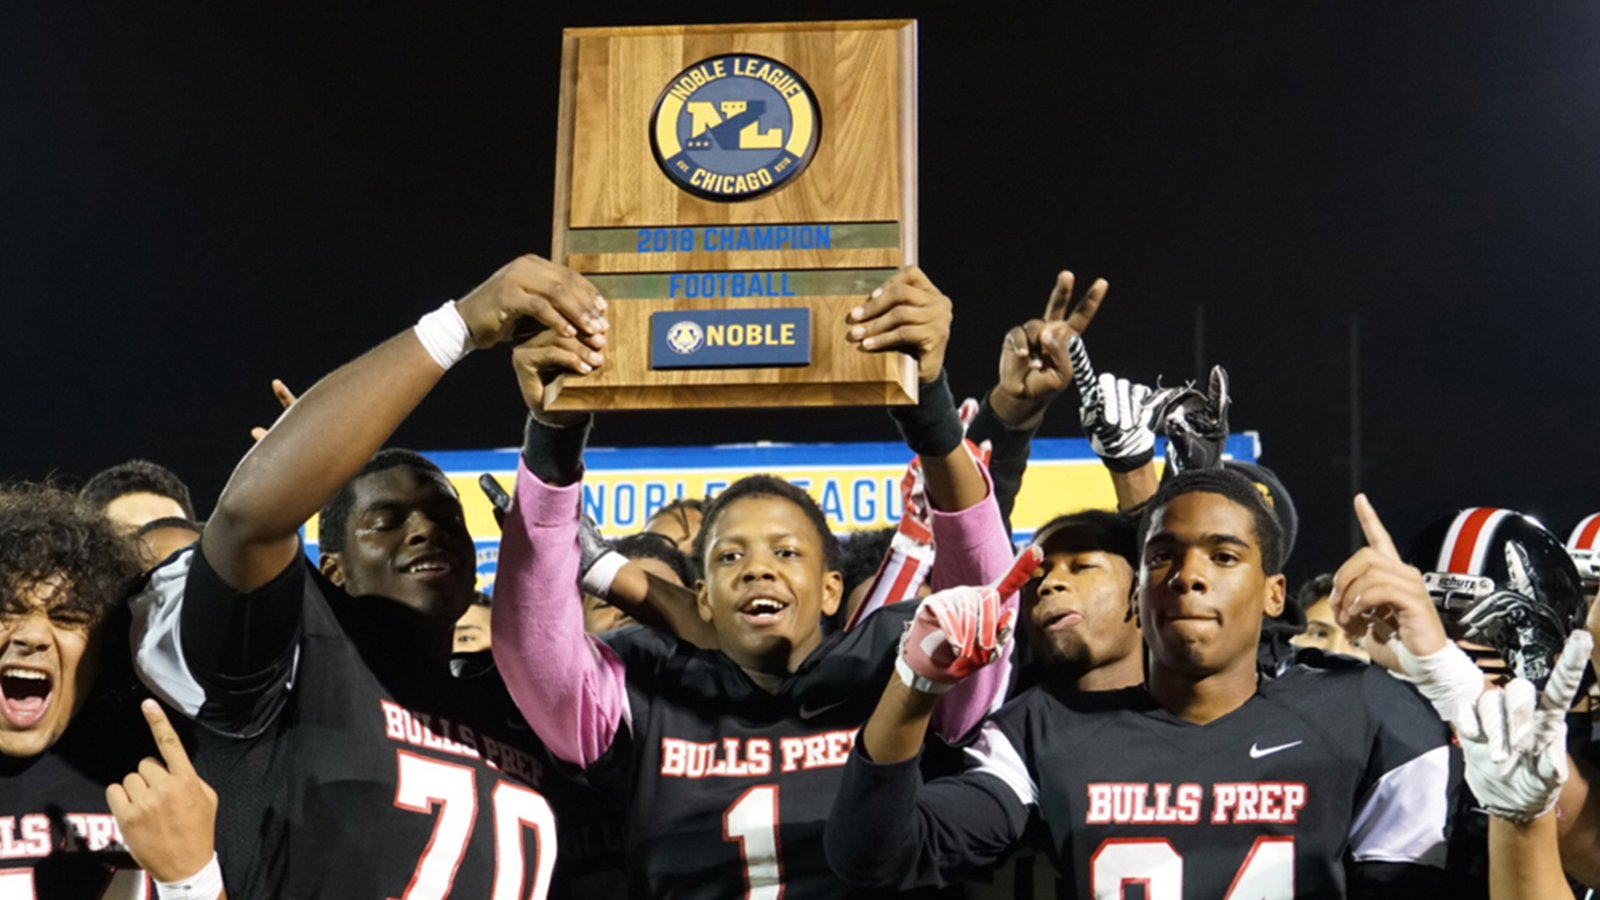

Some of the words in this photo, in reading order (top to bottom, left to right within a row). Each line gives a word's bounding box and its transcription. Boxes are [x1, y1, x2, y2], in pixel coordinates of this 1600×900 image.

[670, 60, 726, 100] NOBLE
[734, 58, 802, 99] LEAGUE
[689, 168, 773, 194] CHICAGO
[637, 228, 695, 253] 2018
[704, 226, 831, 251] CHAMPION
[669, 273, 796, 298] FOOTBALL
[706, 324, 796, 347] NOBLE
[380, 699, 480, 760] BULLS
[480, 734, 544, 787] PREP
[661, 737, 772, 779] BULLS
[1086, 783, 1203, 824] BULLS
[1210, 781, 1308, 824] PREP
[393, 748, 558, 900] 70
[722, 784, 786, 900] 1
